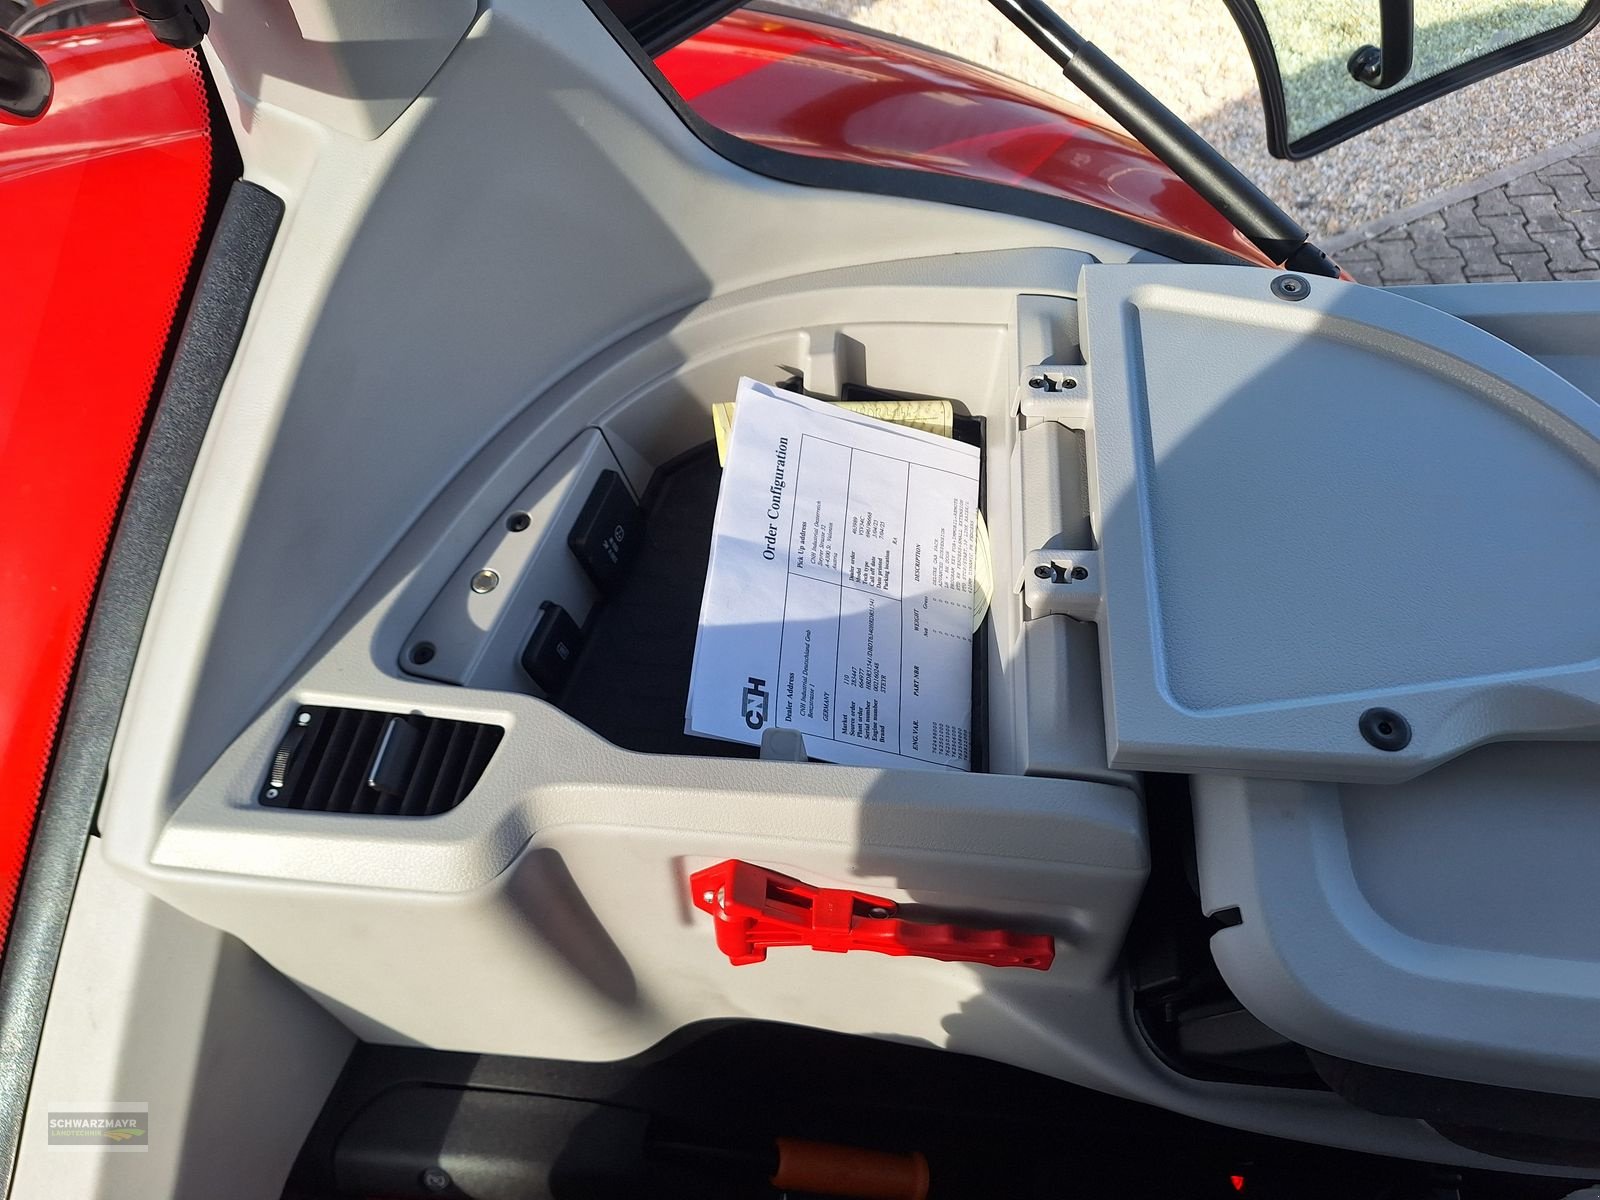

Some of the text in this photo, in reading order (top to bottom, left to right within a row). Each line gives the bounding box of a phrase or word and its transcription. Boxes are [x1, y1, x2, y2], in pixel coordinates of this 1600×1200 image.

[763, 437, 789, 560] Order Configuration
[799, 522, 807, 544] address
[811, 529, 819, 552] Industrial
[798, 546, 805, 554] Up
[802, 643, 810, 676] Deutschland
[746, 677, 766, 730] CNH
[785, 673, 795, 722] Dealer Address
